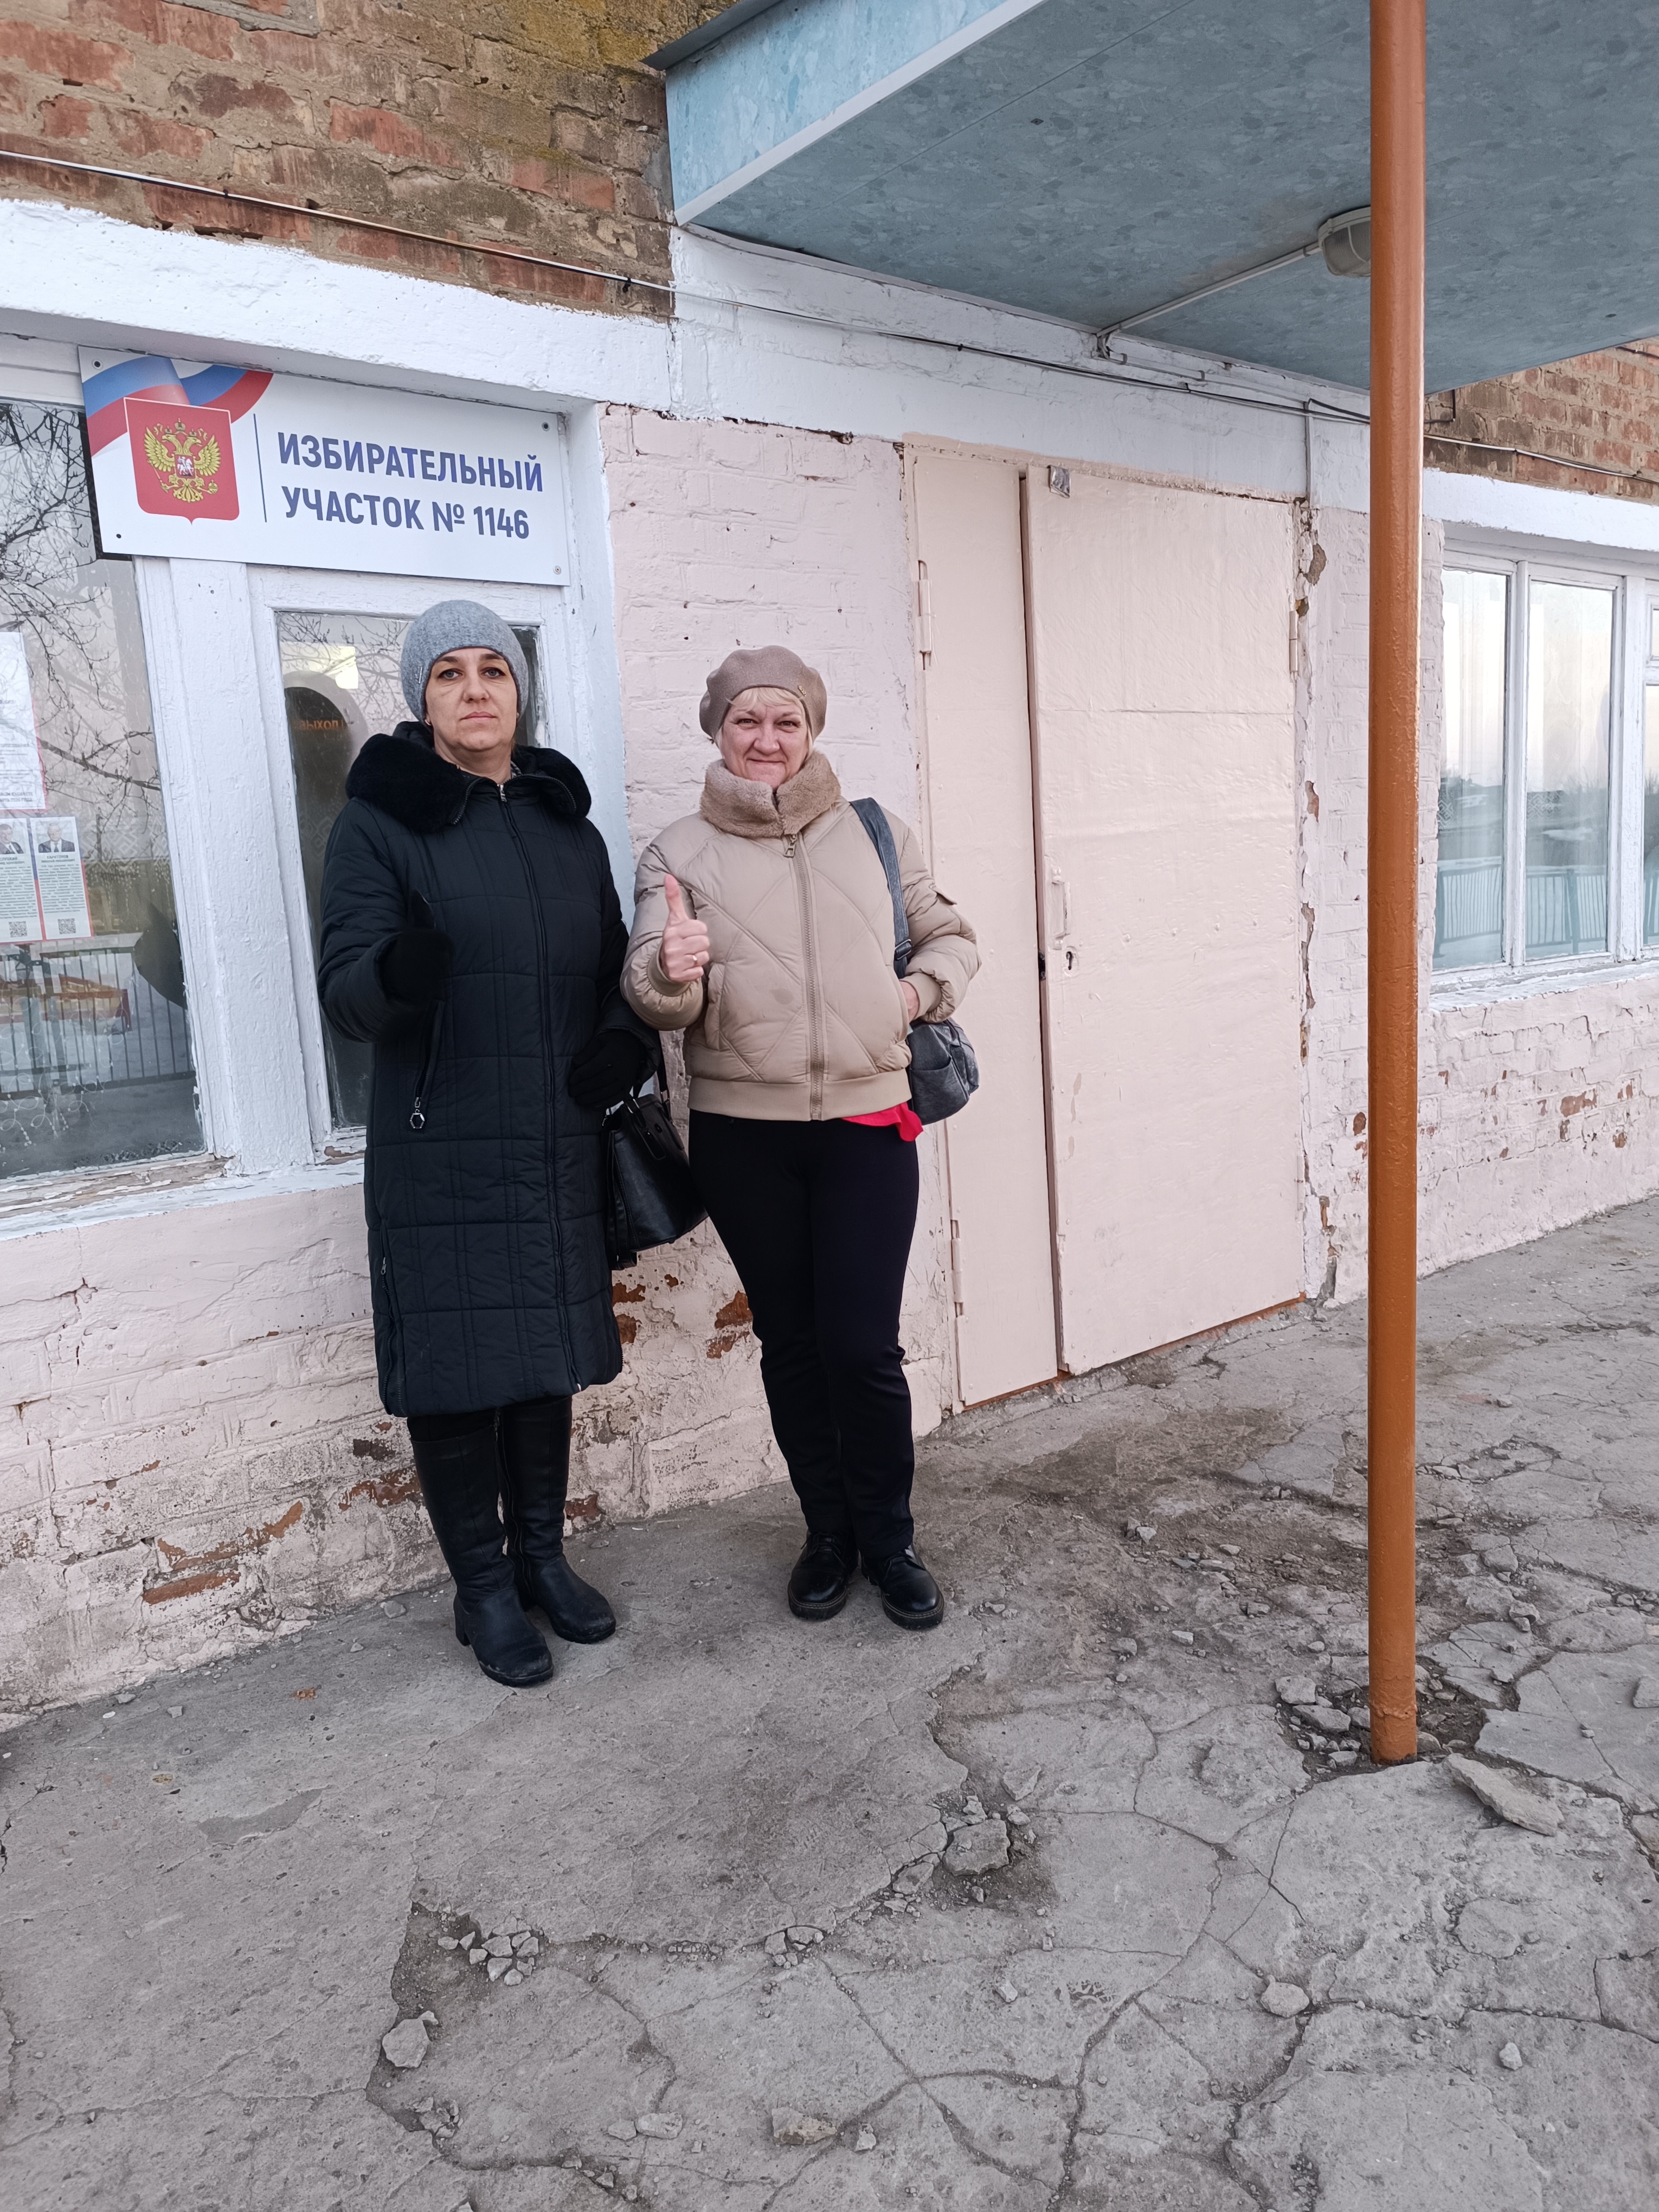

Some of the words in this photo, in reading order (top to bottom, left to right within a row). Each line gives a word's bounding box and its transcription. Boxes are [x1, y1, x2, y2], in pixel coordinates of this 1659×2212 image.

[278, 432, 543, 492] ИЗБИРАТЕЛЬНЫЙ
[281, 486, 425, 530] УЧАСТОК
[432, 501, 465, 532] №
[473, 506, 529, 539] 1146
